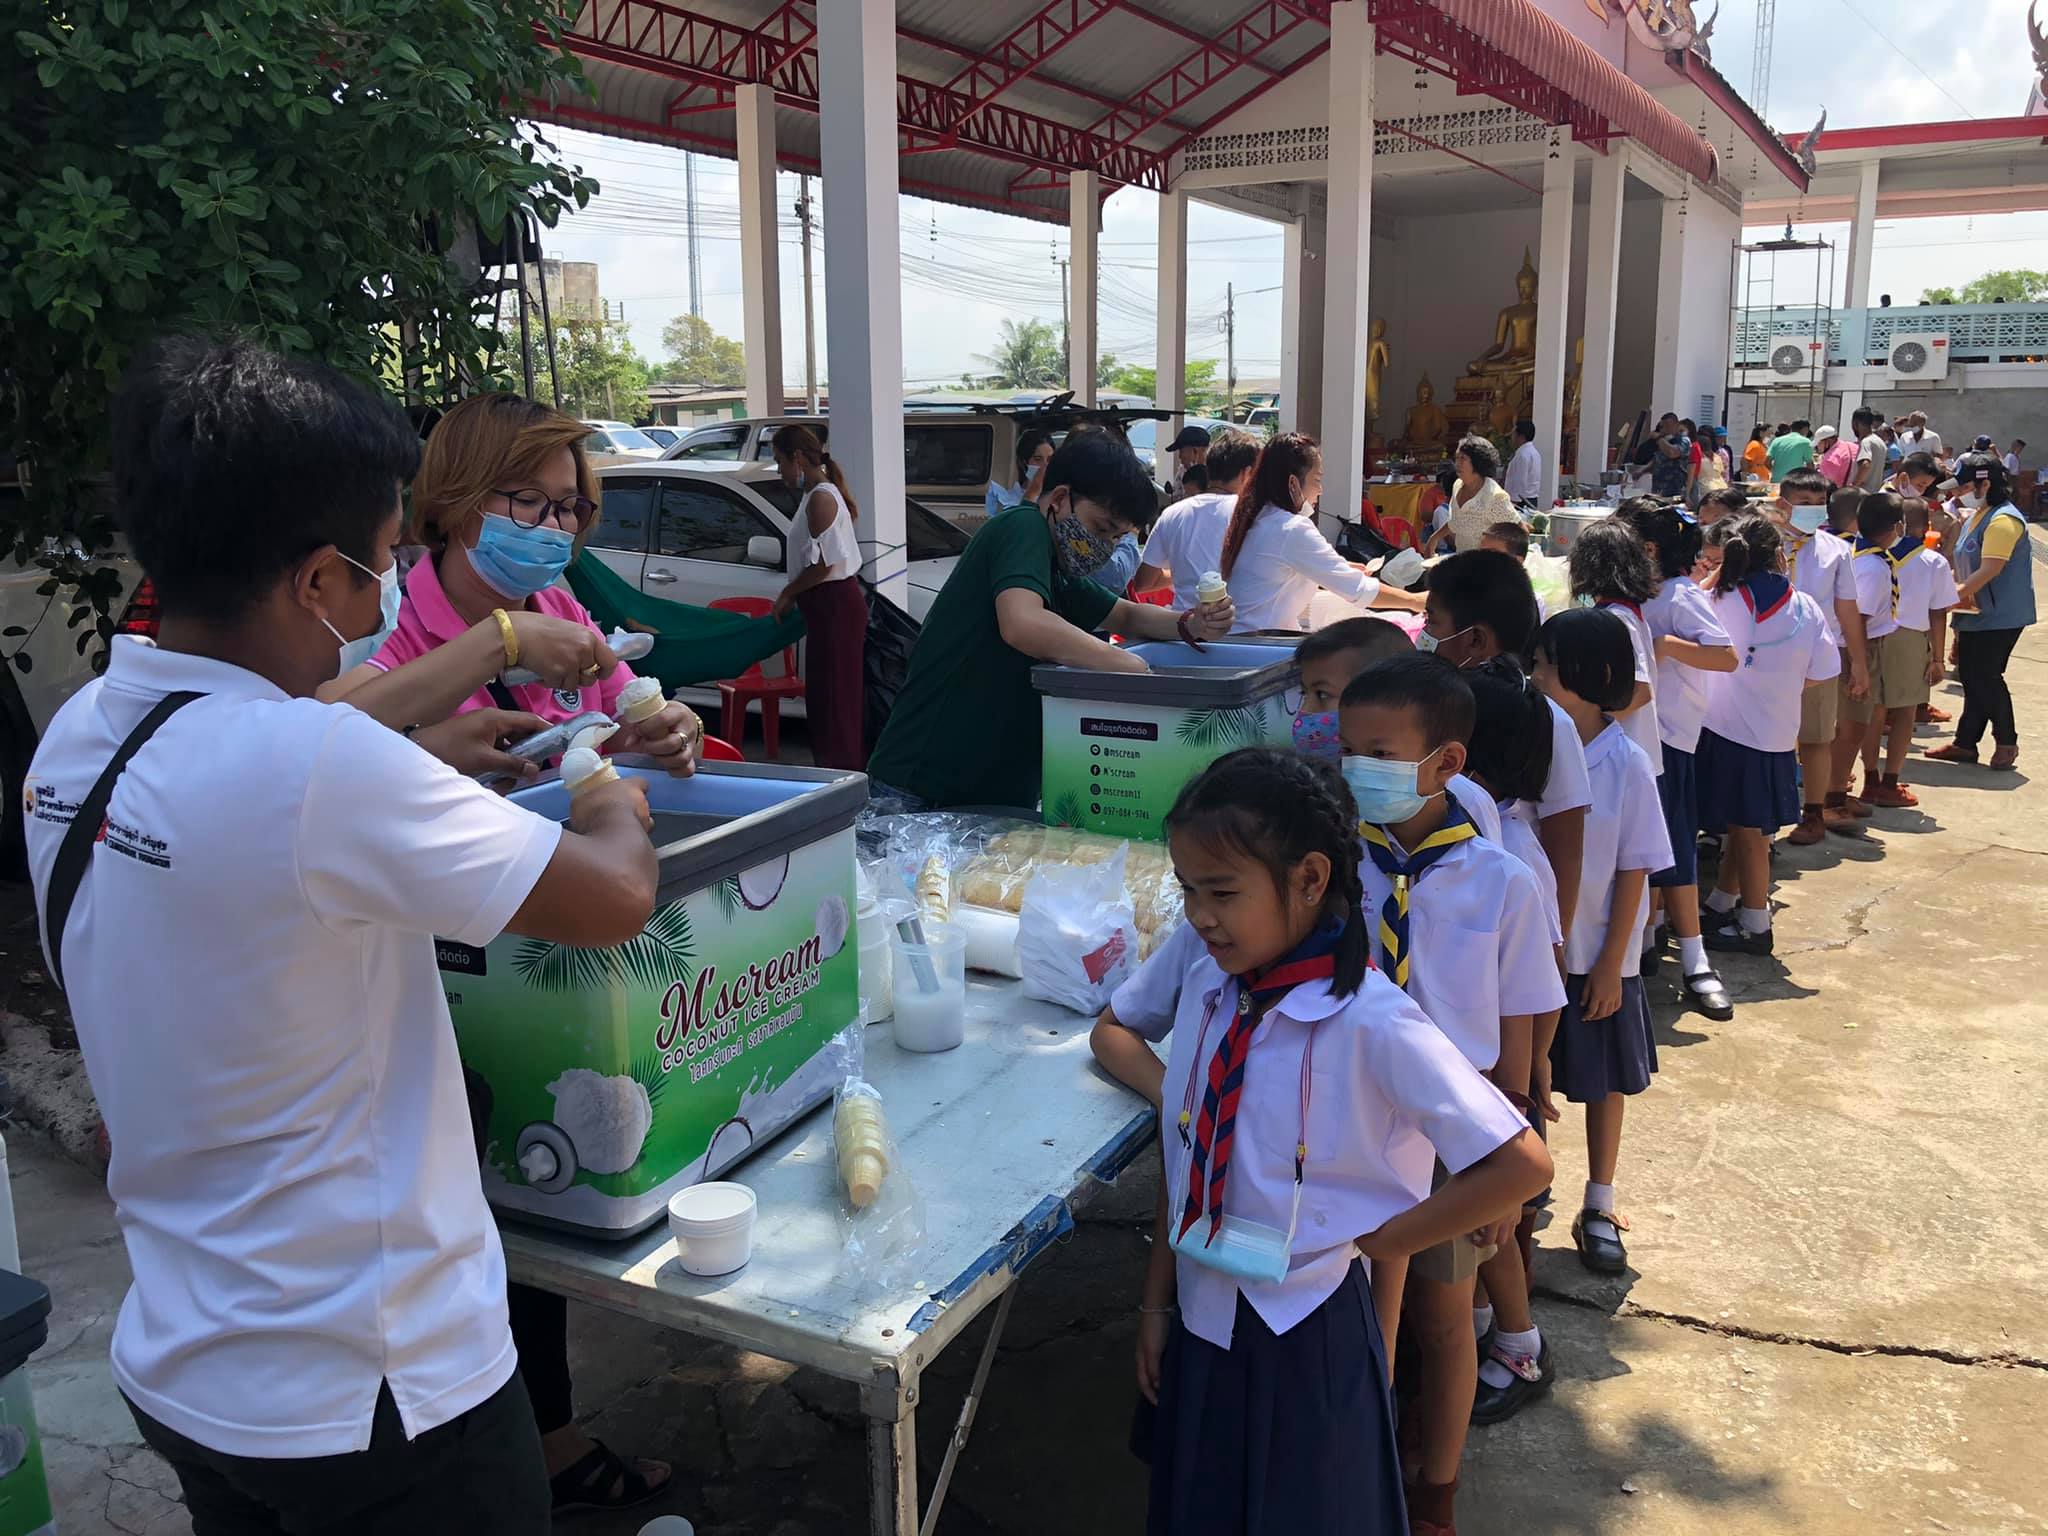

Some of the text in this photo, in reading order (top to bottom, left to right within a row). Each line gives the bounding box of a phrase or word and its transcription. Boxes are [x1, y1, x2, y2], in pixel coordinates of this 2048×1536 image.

[1103, 747, 1141, 759] @mscream
[656, 935, 823, 1051] M'scream
[662, 970, 821, 1071] COCONUT ICE CREAM
[688, 1036, 744, 1084] ไอศกรีมกะทิ
